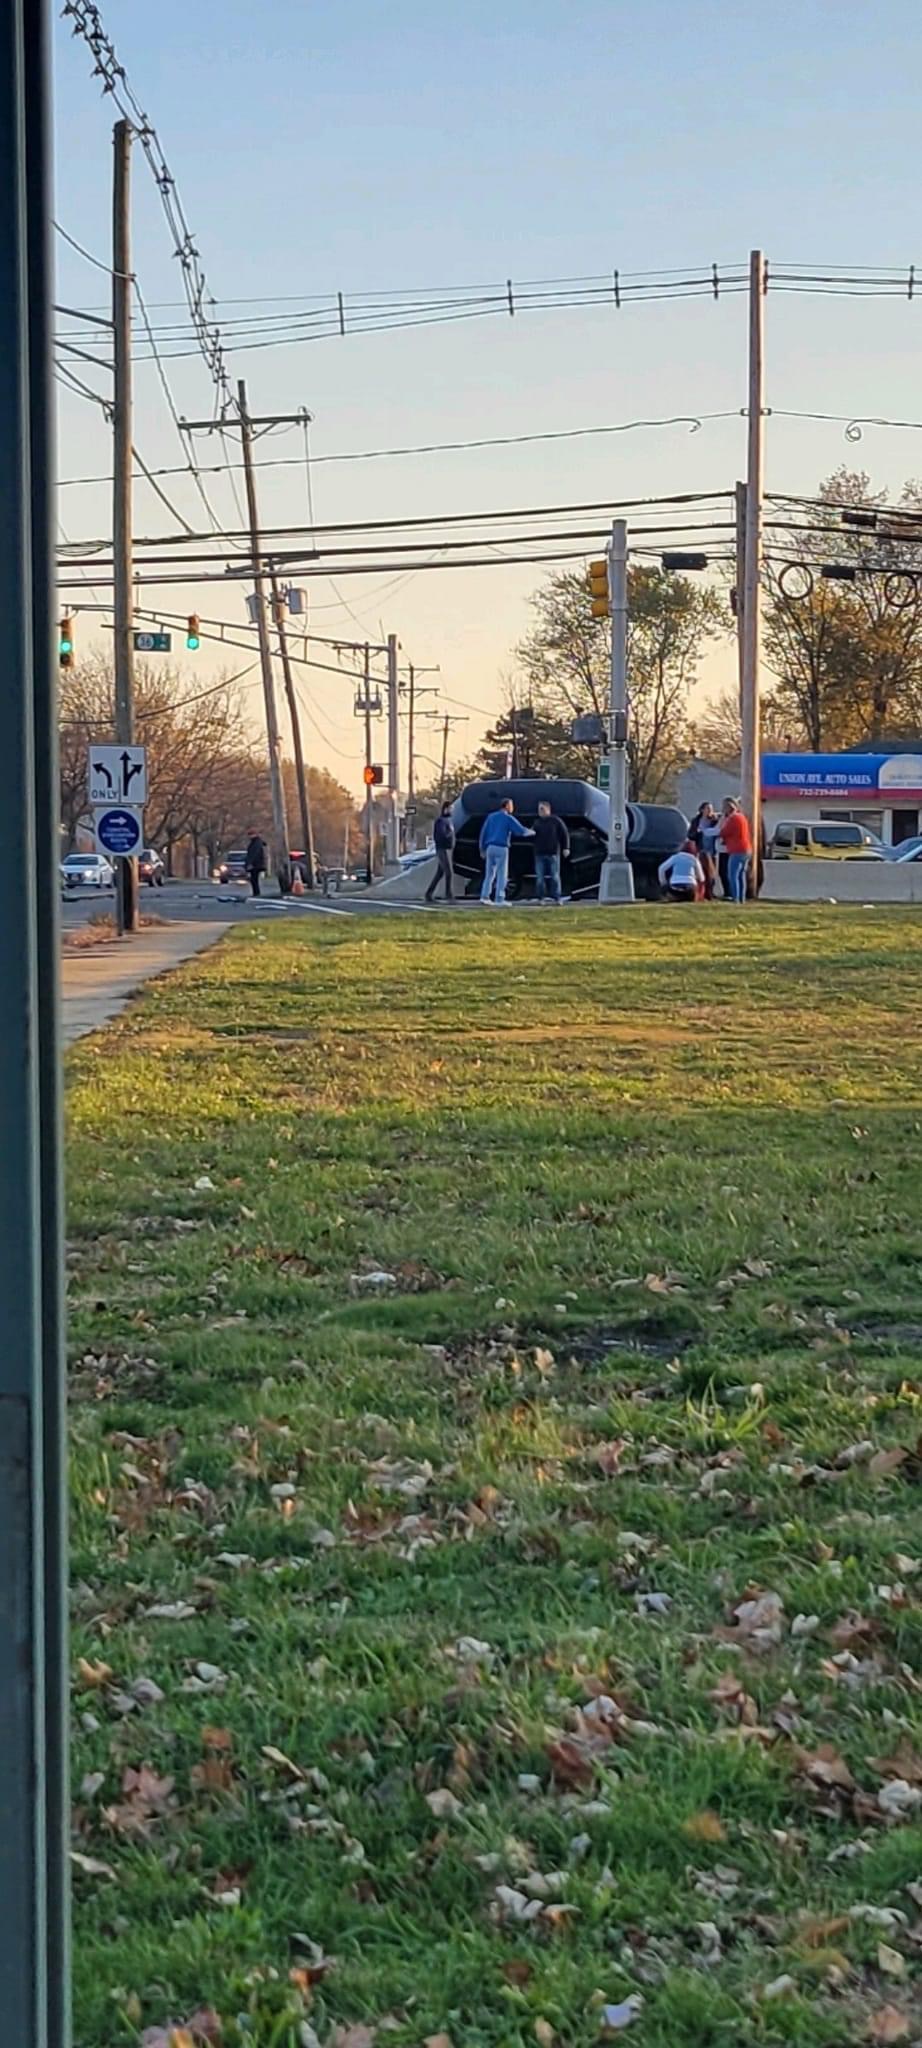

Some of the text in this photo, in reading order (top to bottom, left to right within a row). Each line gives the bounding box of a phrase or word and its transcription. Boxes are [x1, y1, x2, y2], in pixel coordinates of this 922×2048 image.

[779, 773, 805, 783] UNION
[824, 774, 847, 784] AUTO
[848, 774, 872, 785] SALES
[91, 789, 118, 800] ONLY
